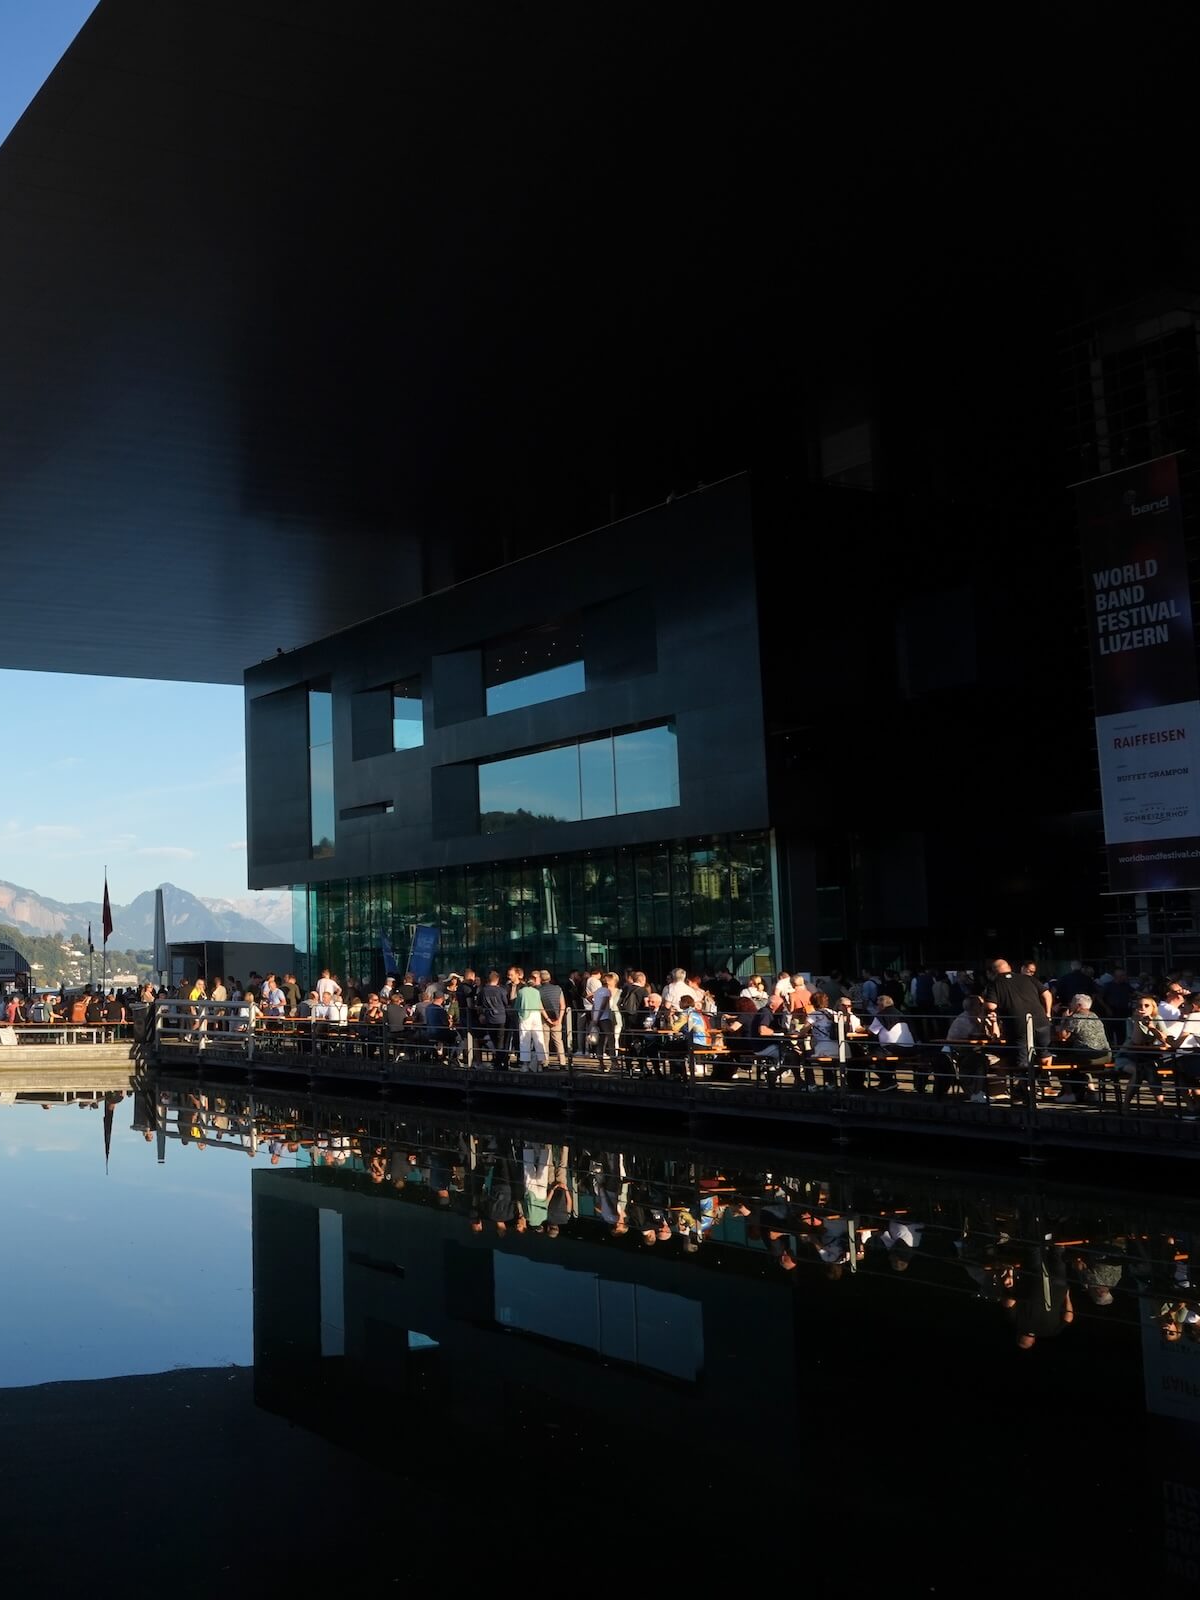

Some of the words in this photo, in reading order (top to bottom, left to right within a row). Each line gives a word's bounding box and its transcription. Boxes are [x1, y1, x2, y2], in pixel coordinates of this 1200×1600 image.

[1092, 559, 1158, 590] WORLD
[1095, 585, 1145, 612] BAND
[1096, 600, 1181, 633] FESTIVAL
[1099, 624, 1169, 656] LUZERN
[1113, 728, 1186, 749] RAIFFEISEN
[1149, 767, 1189, 778] CRAMPON
